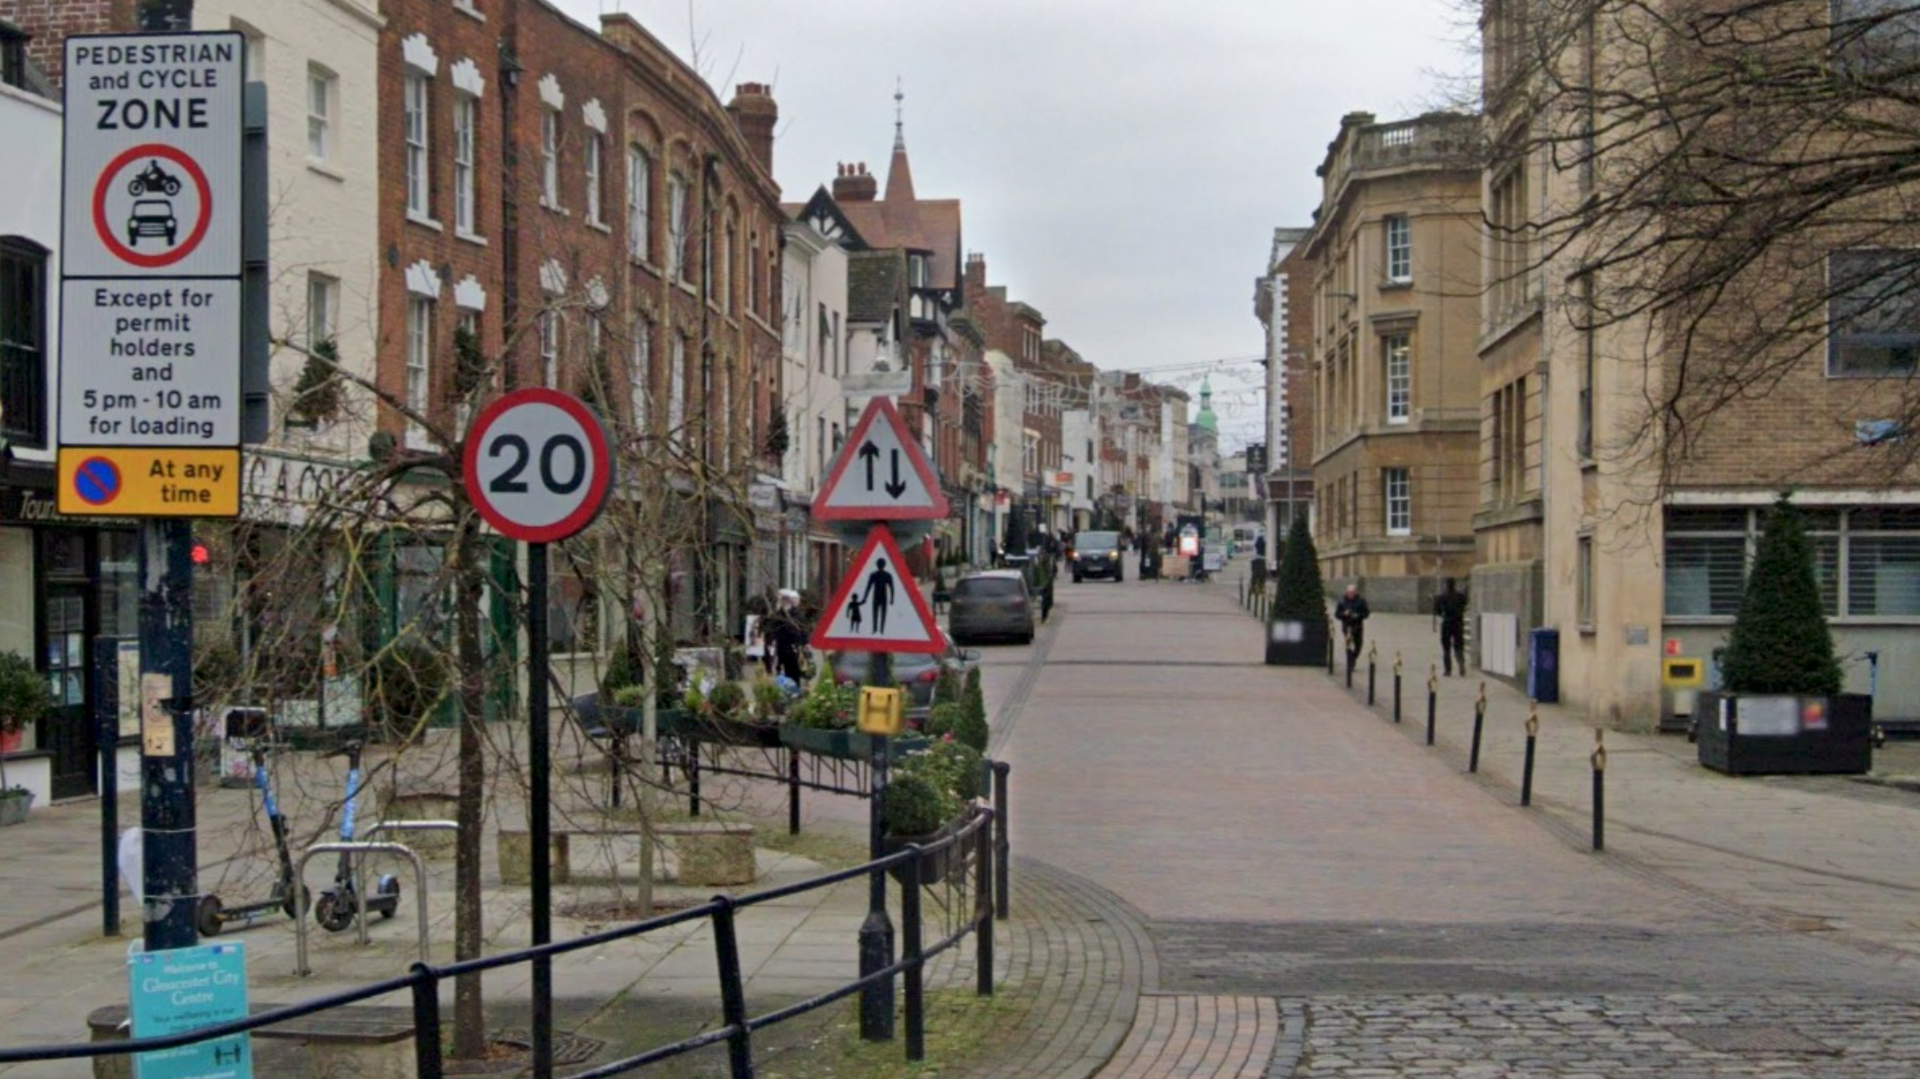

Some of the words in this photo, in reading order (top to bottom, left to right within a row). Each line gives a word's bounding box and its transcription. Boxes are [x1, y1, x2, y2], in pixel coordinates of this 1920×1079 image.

[76, 43, 232, 65] PEDESTRIAN
[89, 71, 129, 90] and
[138, 68, 218, 89] CYCLE
[97, 98, 208, 130] ZONE
[94, 288, 173, 310] Except
[181, 288, 213, 308] for
[116, 314, 191, 334] permit
[110, 338, 196, 357] holders
[131, 363, 173, 381] and
[89, 416, 121, 435] for
[131, 416, 214, 438] loading
[149, 459, 174, 478] At
[184, 463, 224, 482] any
[488, 433, 586, 495] 20
[161, 484, 211, 503] time
[852, 681, 867, 699] H
[143, 977, 210, 993] Gloucester
[213, 970, 238, 985] City
[172, 991, 213, 1005] Centre
